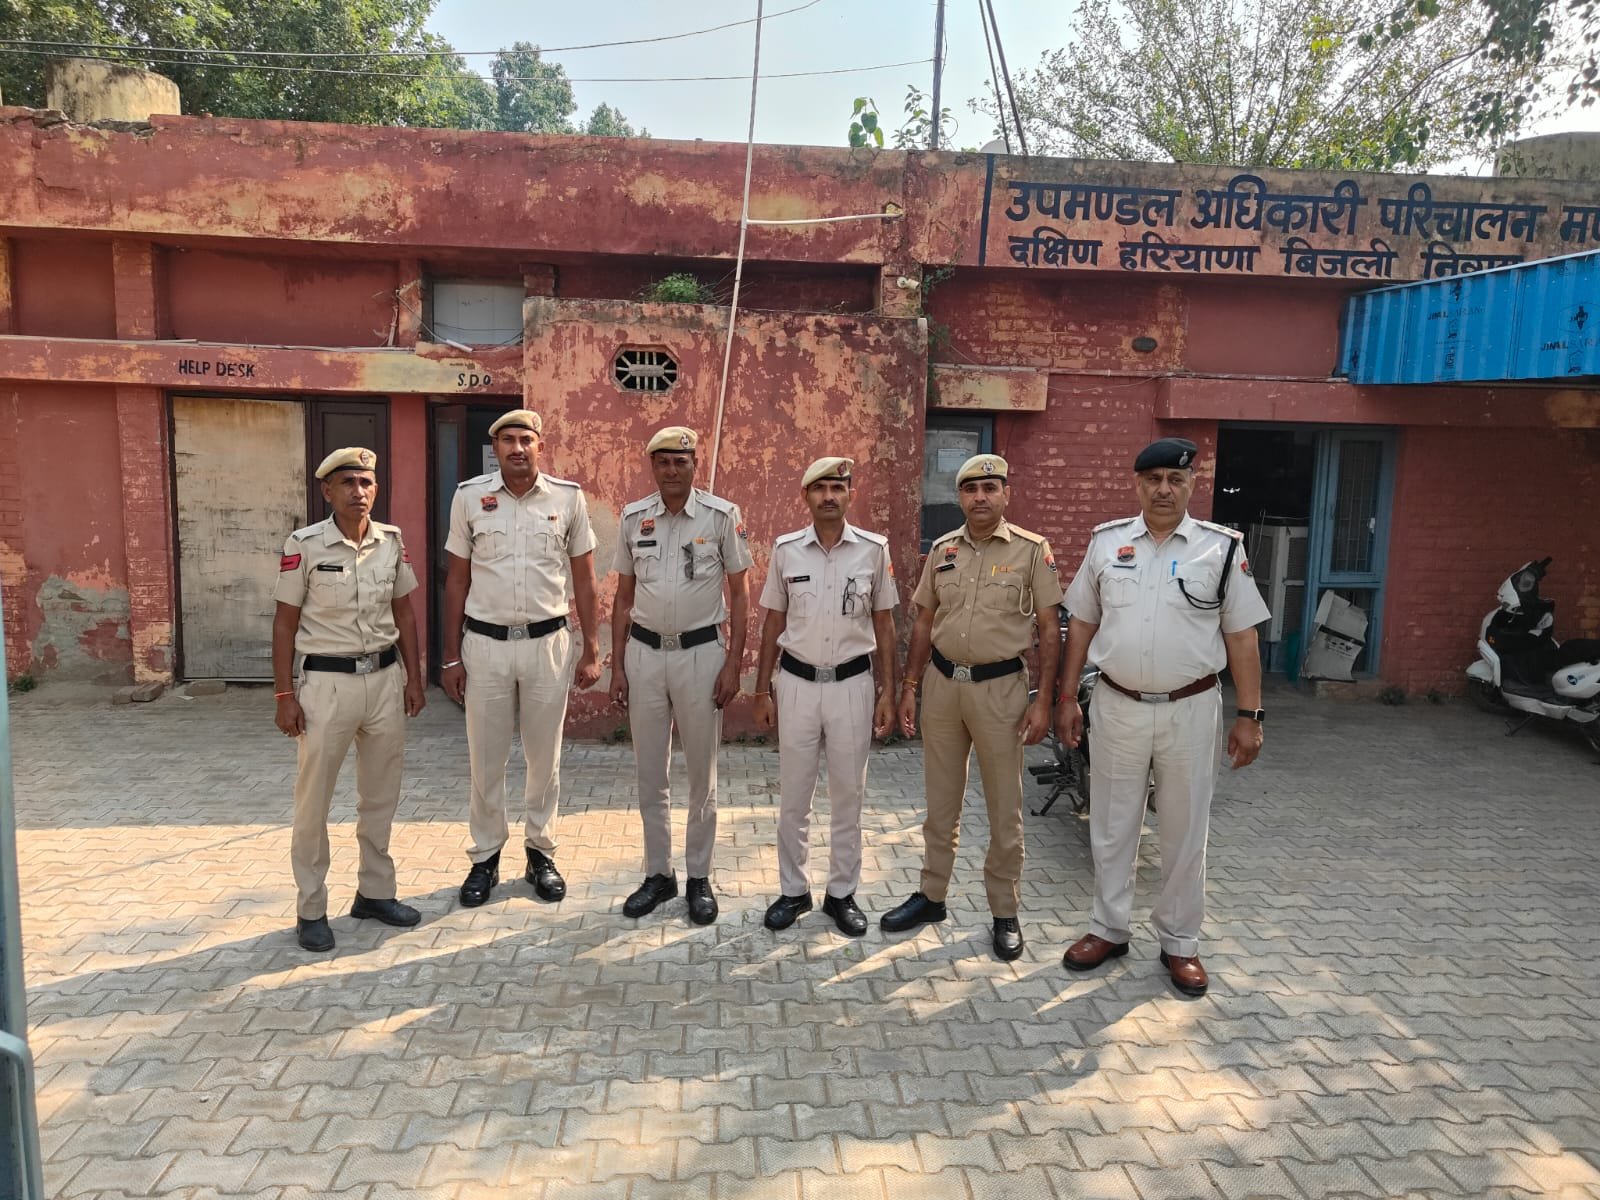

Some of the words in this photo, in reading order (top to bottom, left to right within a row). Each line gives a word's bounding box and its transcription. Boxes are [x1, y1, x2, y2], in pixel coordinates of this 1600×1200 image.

[1005, 181, 1182, 227] उपमण्डल
[1190, 174, 1368, 235] अधिकारी
[1377, 183, 1547, 242] परिचालन
[1008, 226, 1103, 268] दक्षिण
[1119, 231, 1260, 272] हरियाणा
[1279, 237, 1398, 278] बिजली
[178, 359, 211, 375] HELP
[216, 362, 255, 377] DESK
